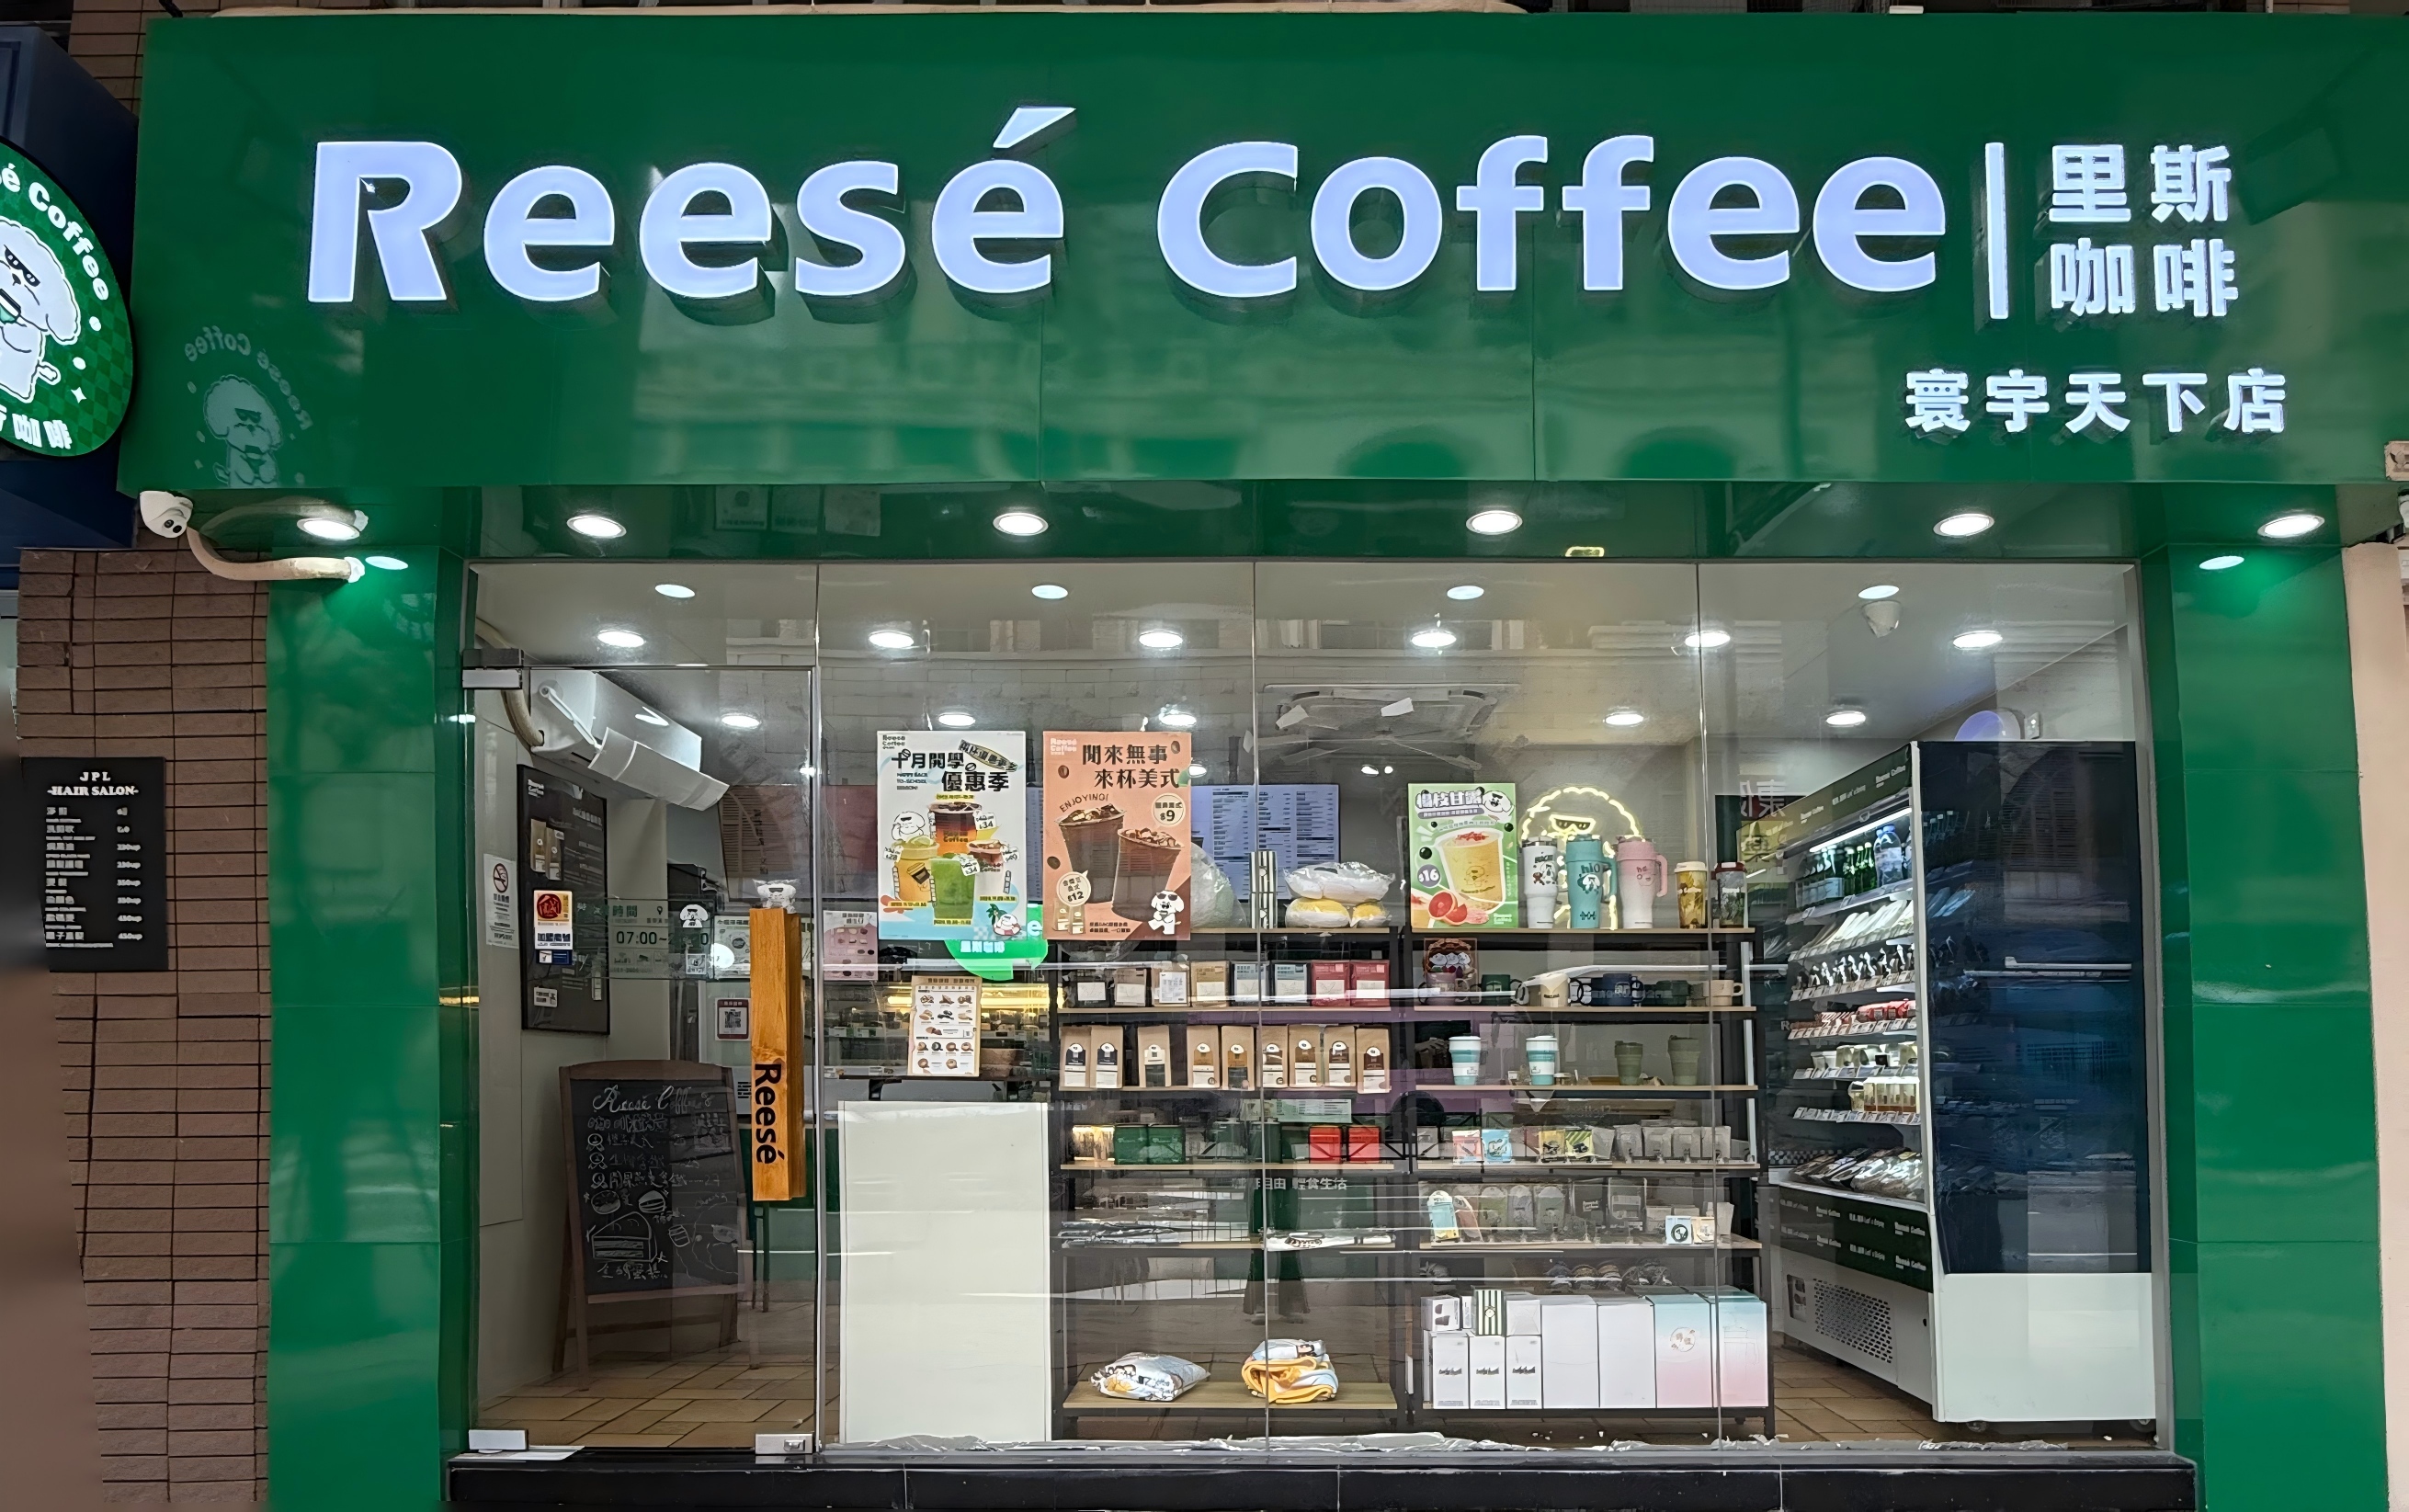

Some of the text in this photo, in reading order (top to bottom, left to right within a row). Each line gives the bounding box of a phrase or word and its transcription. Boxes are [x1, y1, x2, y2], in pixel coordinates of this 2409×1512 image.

[308, 106, 1947, 304] Reesé Coffee
[2049, 143, 2232, 222] 里斯
[28, 181, 109, 301] Coffee
[2051, 237, 2239, 317] 咖啡
[0, 404, 73, 450] 咖啡
[1904, 368, 2288, 433] 寰宇天下店
[51, 785, 135, 797] HAIR SALON
[941, 770, 1009, 792] 優惠季
[1094, 768, 1180, 789] 來杯美式
[1418, 868, 1440, 882] $16
[754, 1063, 785, 1165] Reesé
